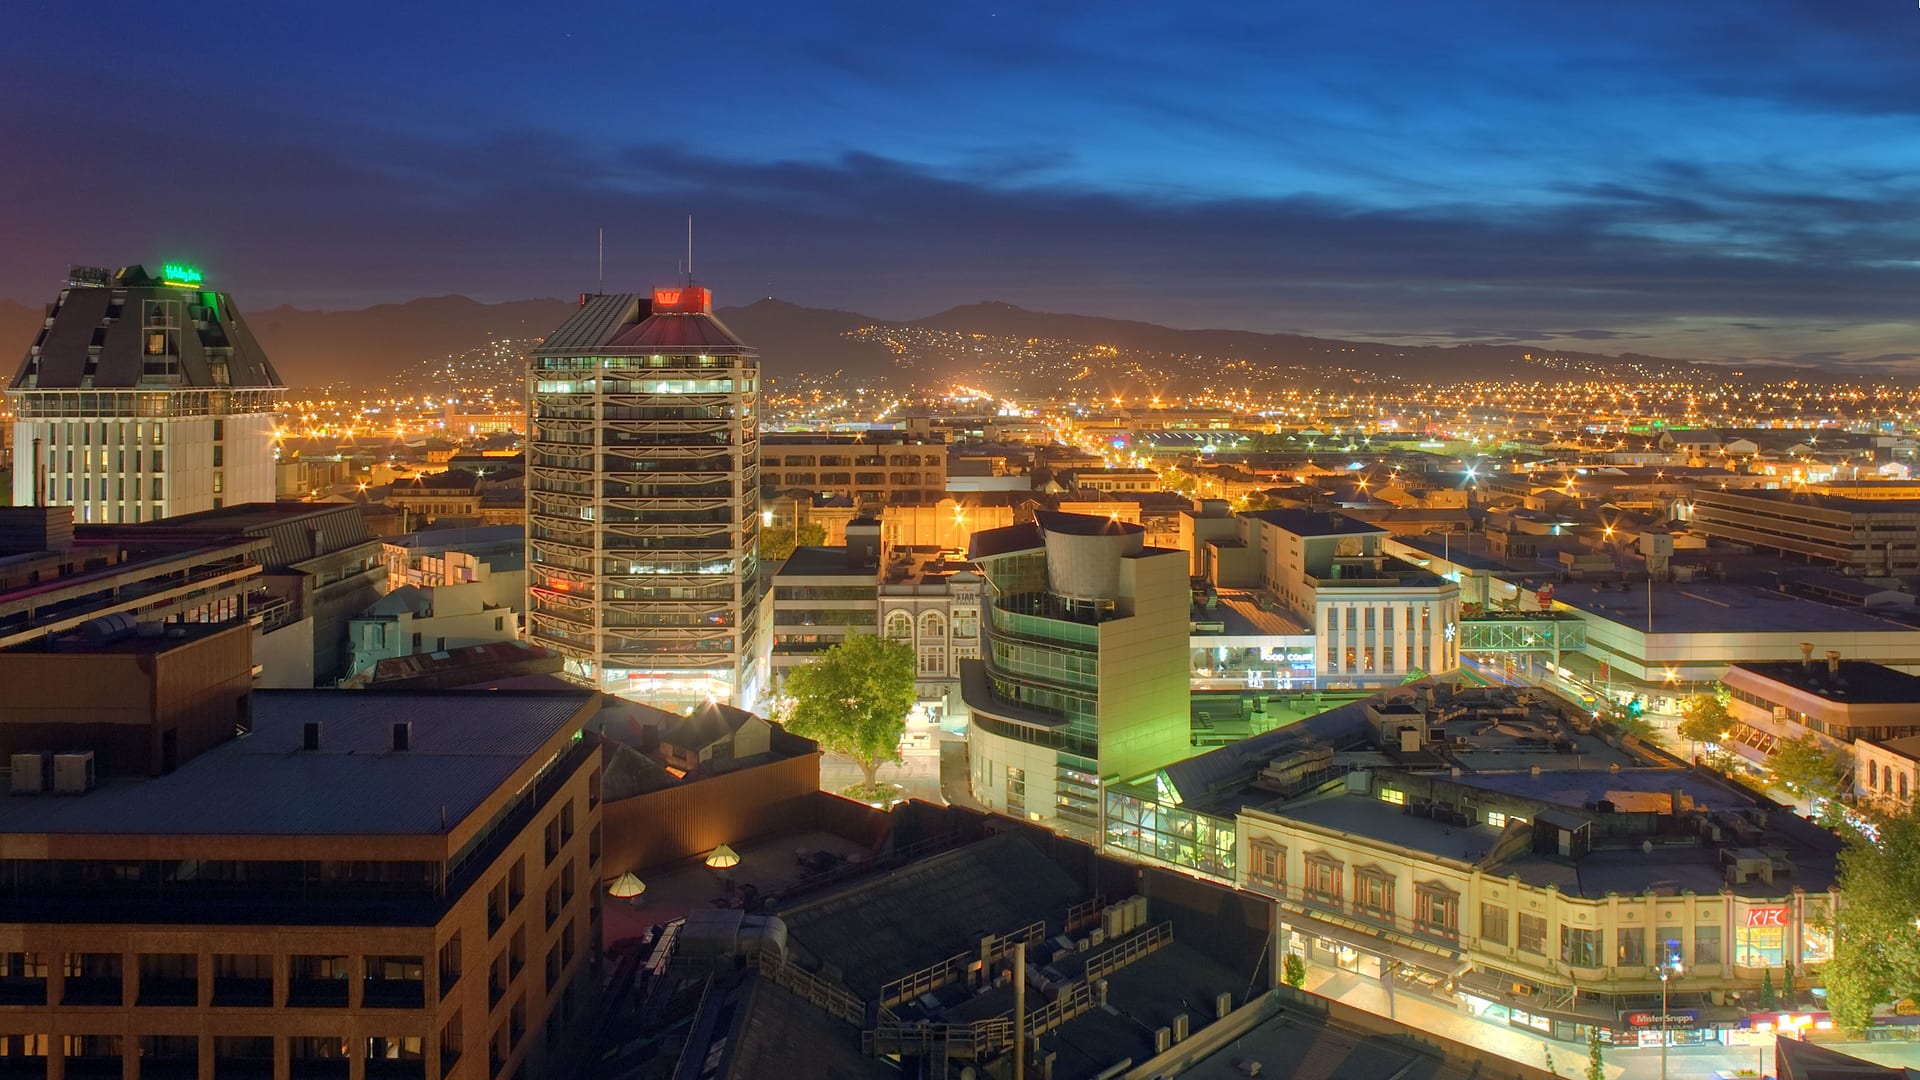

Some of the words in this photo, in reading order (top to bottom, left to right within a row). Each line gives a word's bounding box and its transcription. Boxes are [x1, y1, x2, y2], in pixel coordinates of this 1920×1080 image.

[166, 265, 188, 282] Holiday
[188, 268, 201, 280] Inn
[1261, 653, 1284, 661] FOOD
[1746, 909, 1784, 926] KFC
